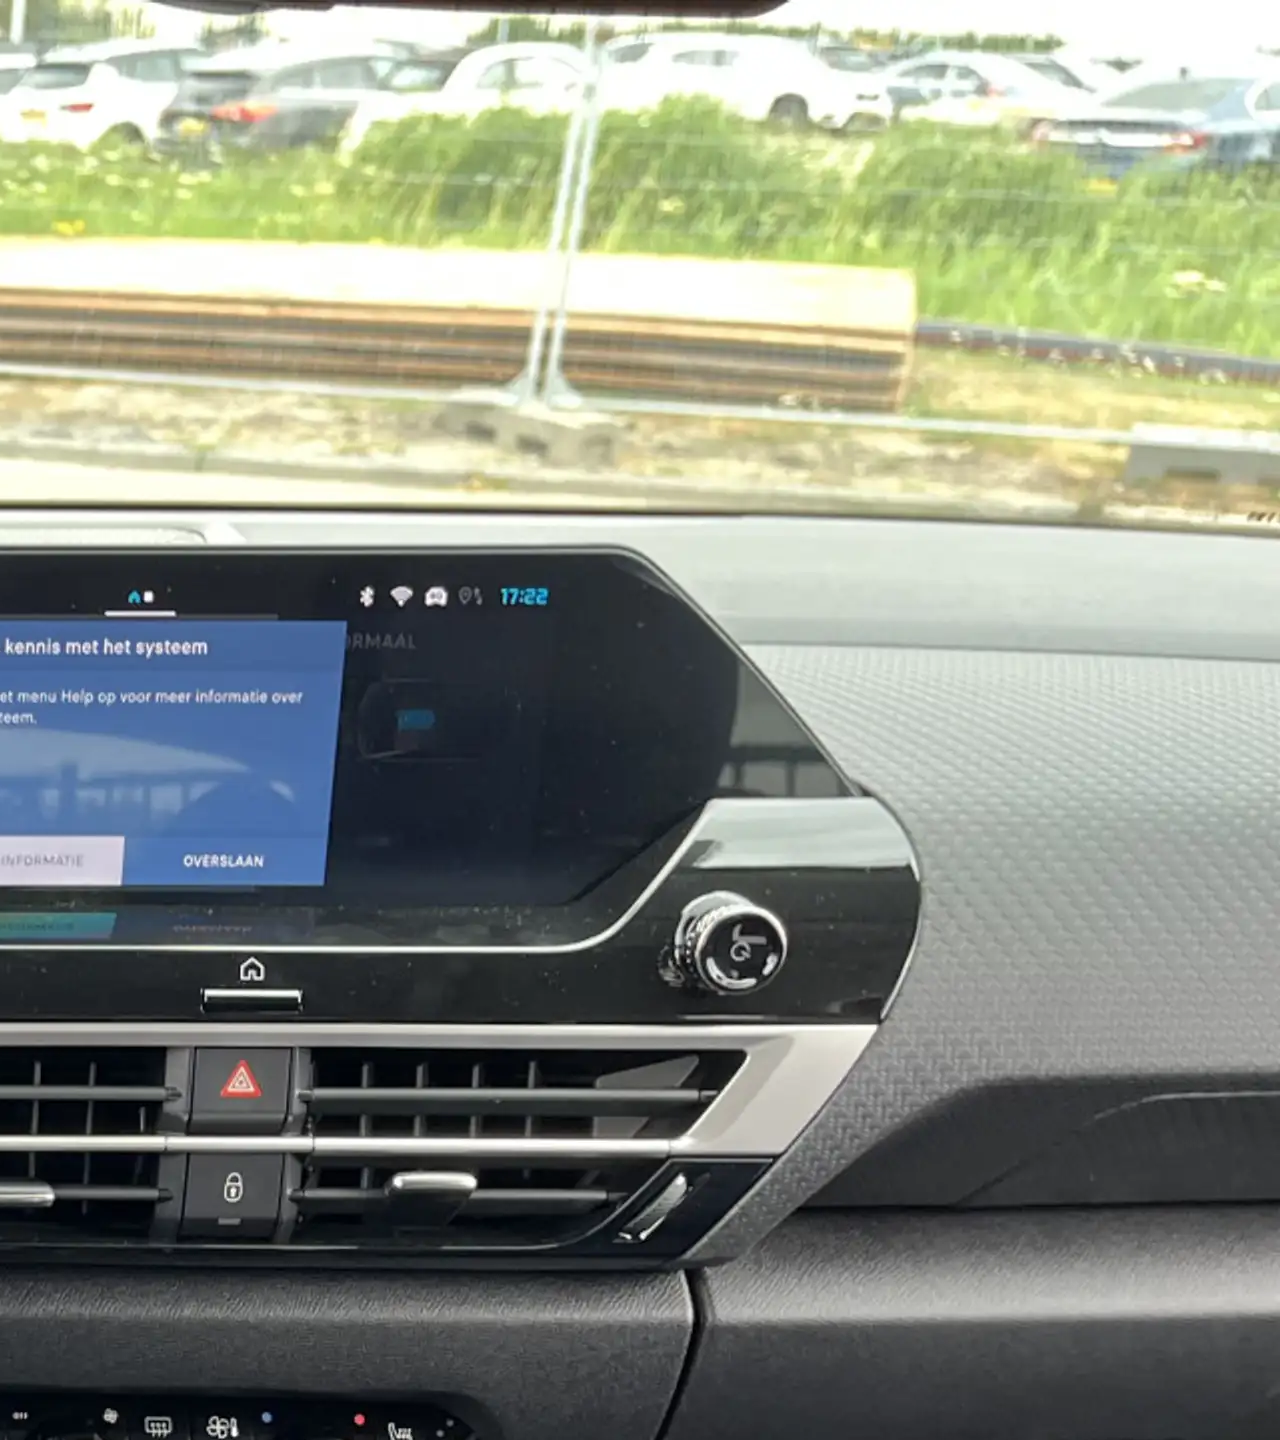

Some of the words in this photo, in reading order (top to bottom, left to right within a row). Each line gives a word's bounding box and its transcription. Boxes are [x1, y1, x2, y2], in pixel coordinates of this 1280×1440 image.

[501, 587, 549, 605] 17:22
[5, 637, 61, 655] kennis
[66, 640, 100, 655] met
[103, 638, 131, 655] het
[136, 640, 208, 659] systeem
[17, 690, 57, 703] menu
[61, 688, 93, 705] Help
[97, 691, 116, 706] op
[120, 690, 151, 703] voor
[155, 691, 190, 703] meer
[195, 688, 268, 703] informatie
[271, 690, 304, 703] over
[0, 852, 84, 868] INFORMATIE
[182, 854, 264, 869] OVERSLAAN
